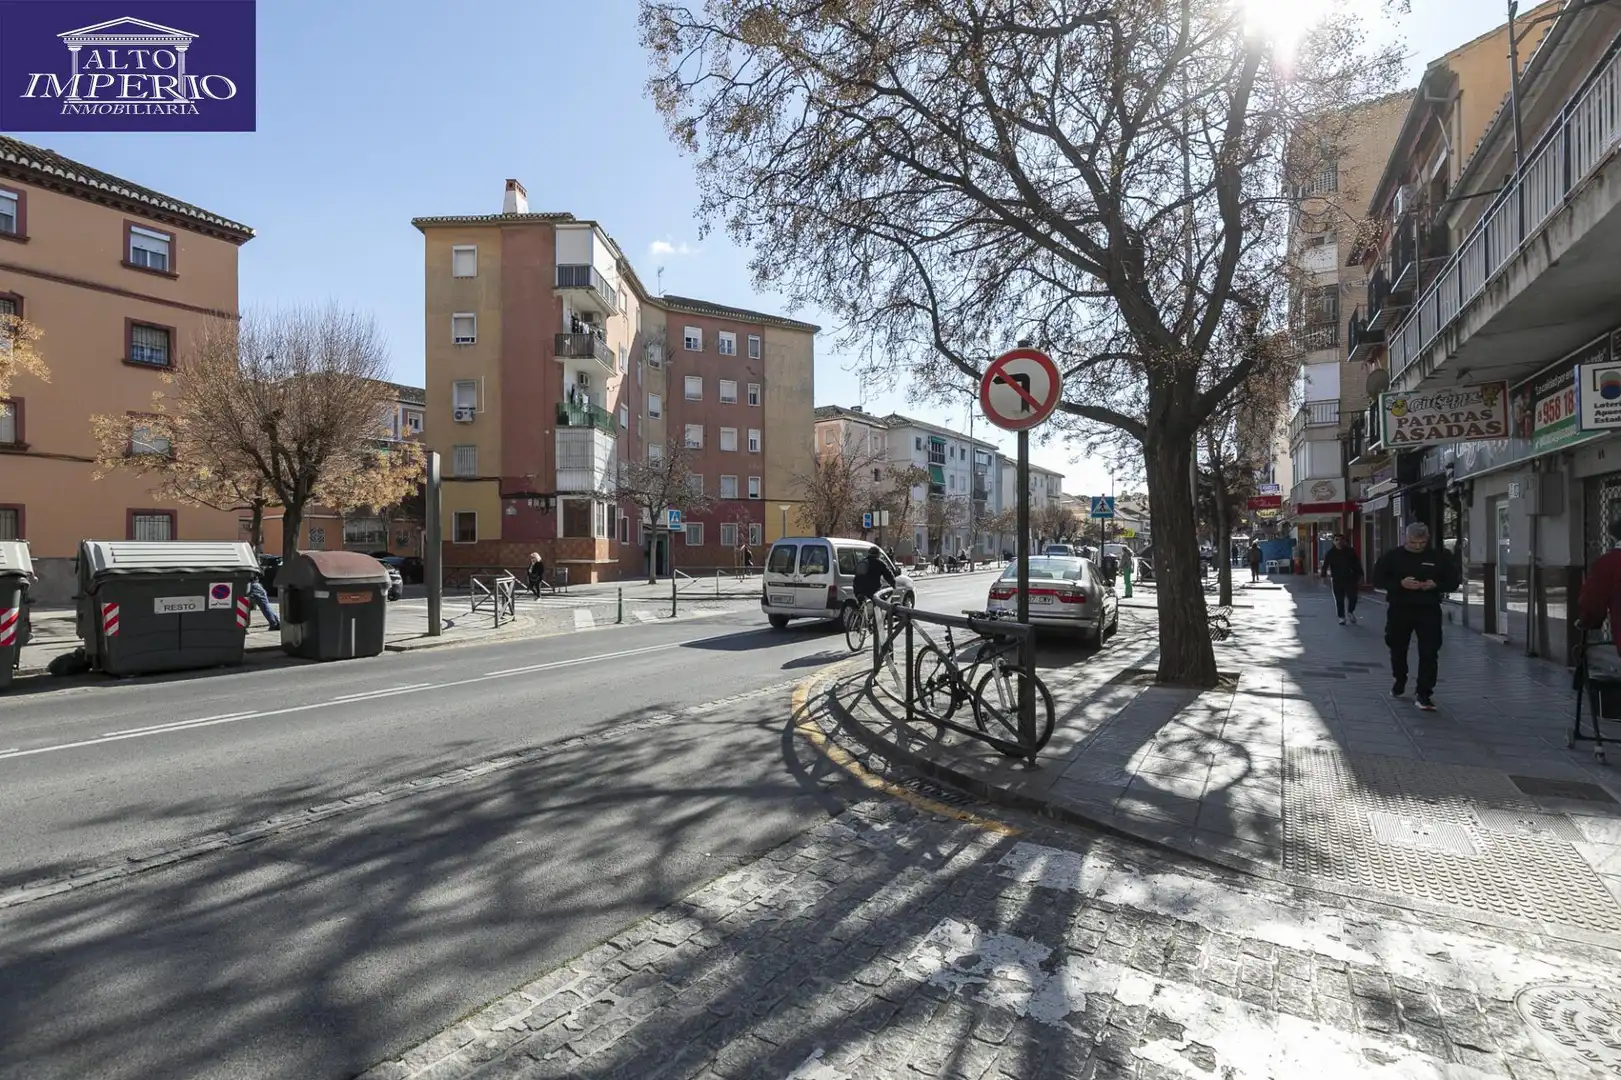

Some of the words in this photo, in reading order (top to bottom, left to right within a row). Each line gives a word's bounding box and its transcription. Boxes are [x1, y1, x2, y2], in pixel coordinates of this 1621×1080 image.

[1396, 409, 1493, 428] PATATAS
[1543, 396, 1561, 425] 958
[1391, 420, 1502, 442] ASADAS
[164, 603, 196, 611] RESTO
